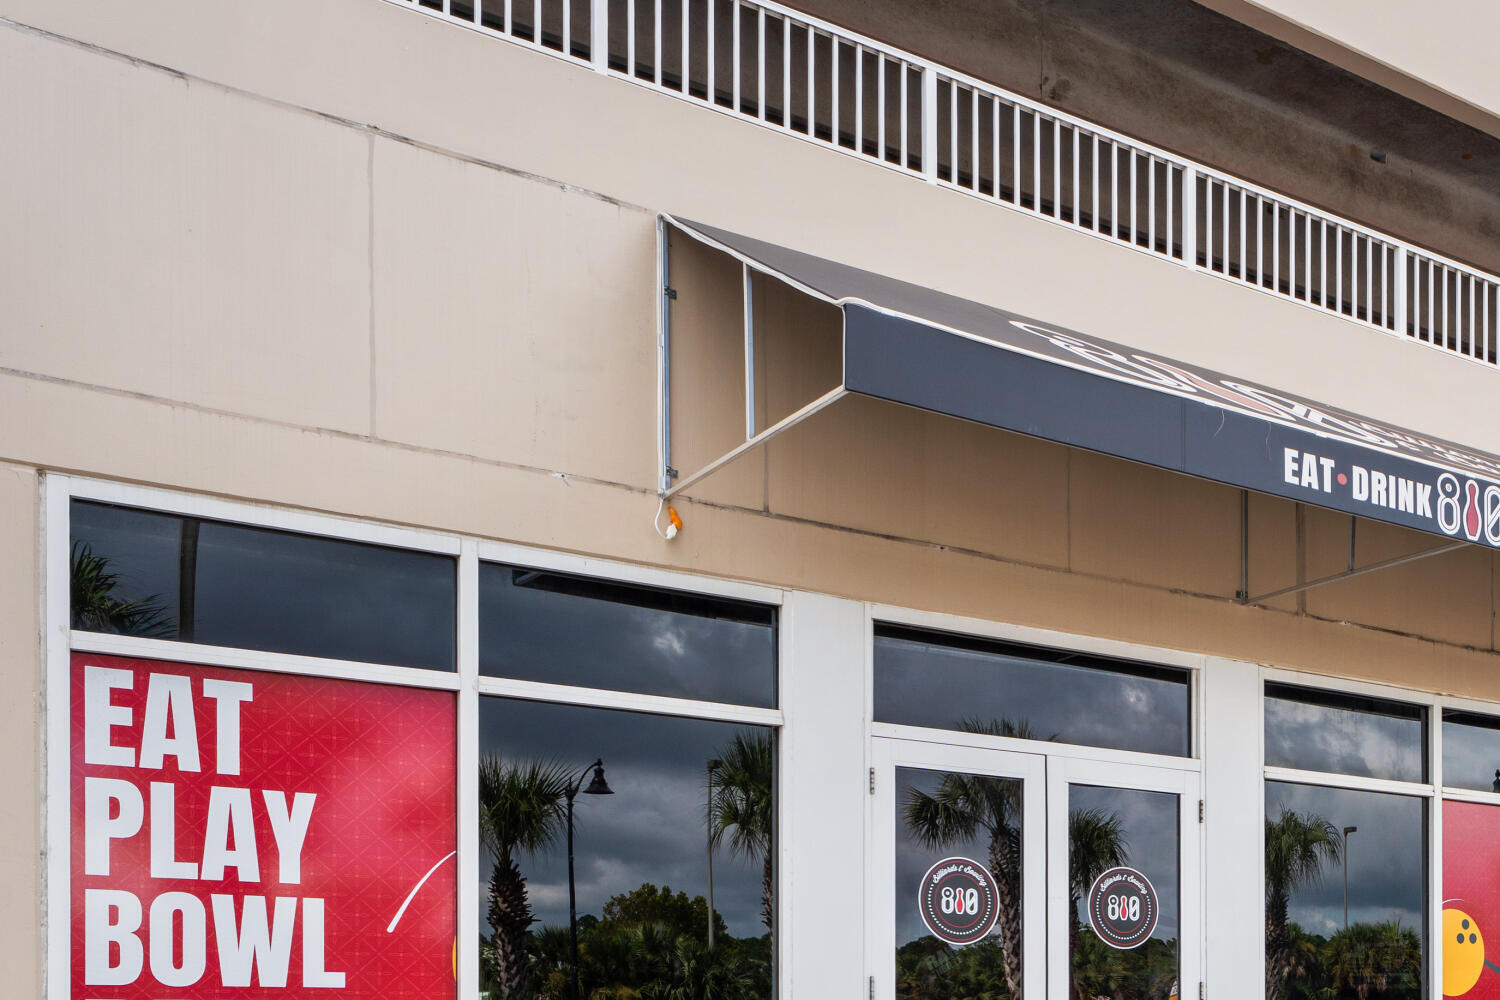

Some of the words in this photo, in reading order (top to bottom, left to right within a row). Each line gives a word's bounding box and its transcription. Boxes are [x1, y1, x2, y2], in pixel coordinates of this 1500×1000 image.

[1284, 447, 1335, 494] EAT
[1352, 465, 1432, 519] DRINK
[84, 665, 253, 775] EAT
[84, 777, 317, 884] PLAY
[84, 889, 346, 988] BOWL
[941, 886, 978, 915] 810
[1107, 894, 1140, 921] 810
